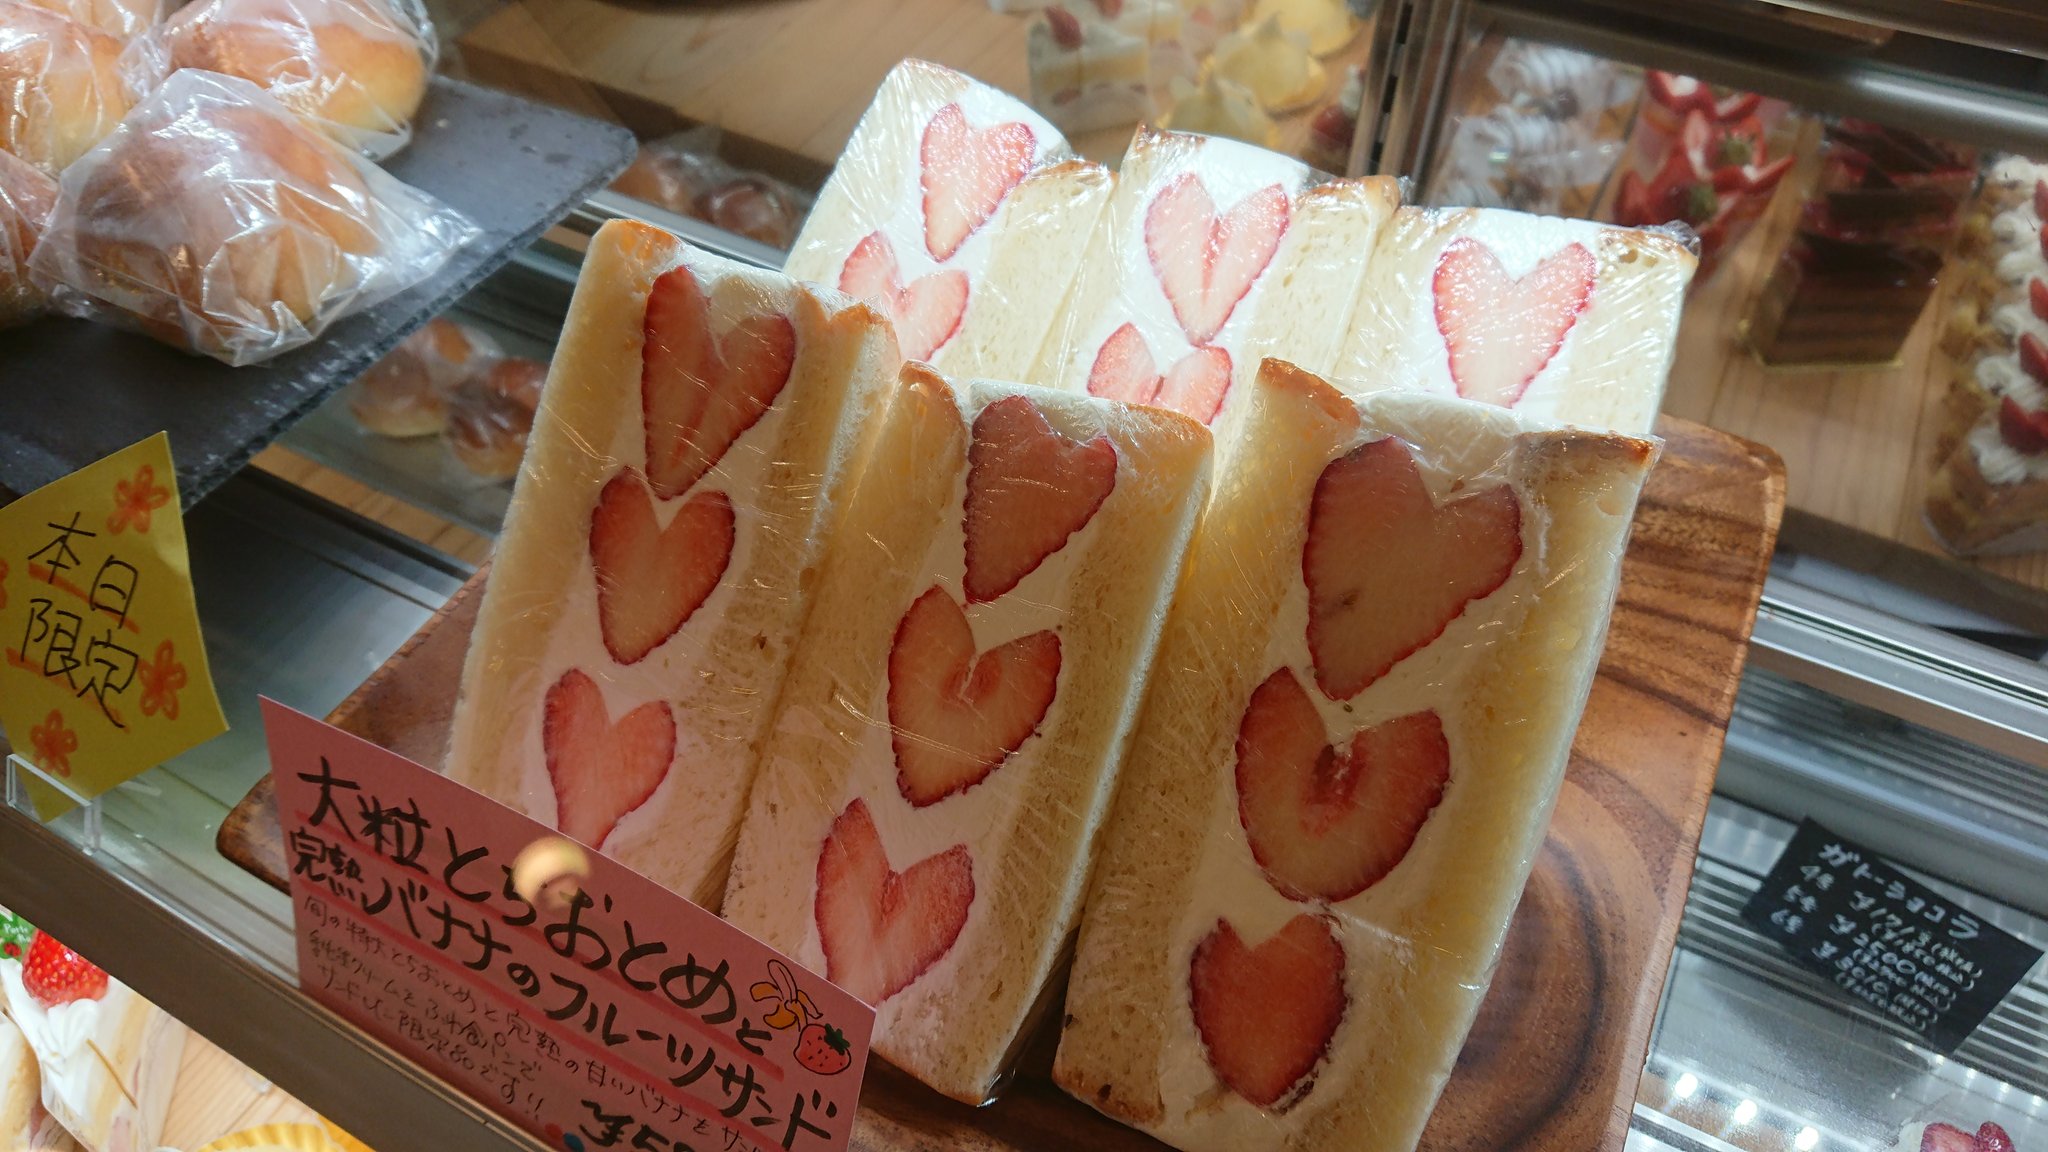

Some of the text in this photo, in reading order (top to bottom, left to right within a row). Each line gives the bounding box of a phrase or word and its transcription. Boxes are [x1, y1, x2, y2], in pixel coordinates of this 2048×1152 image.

[27, 511, 138, 629] 本日
[20, 598, 139, 728] 限定
[1819, 844, 1980, 940] ガトーショコラ
[289, 826, 838, 1150] 完熟バナナのフルーツサンド
[578, 1098, 698, 1152] ¥5
